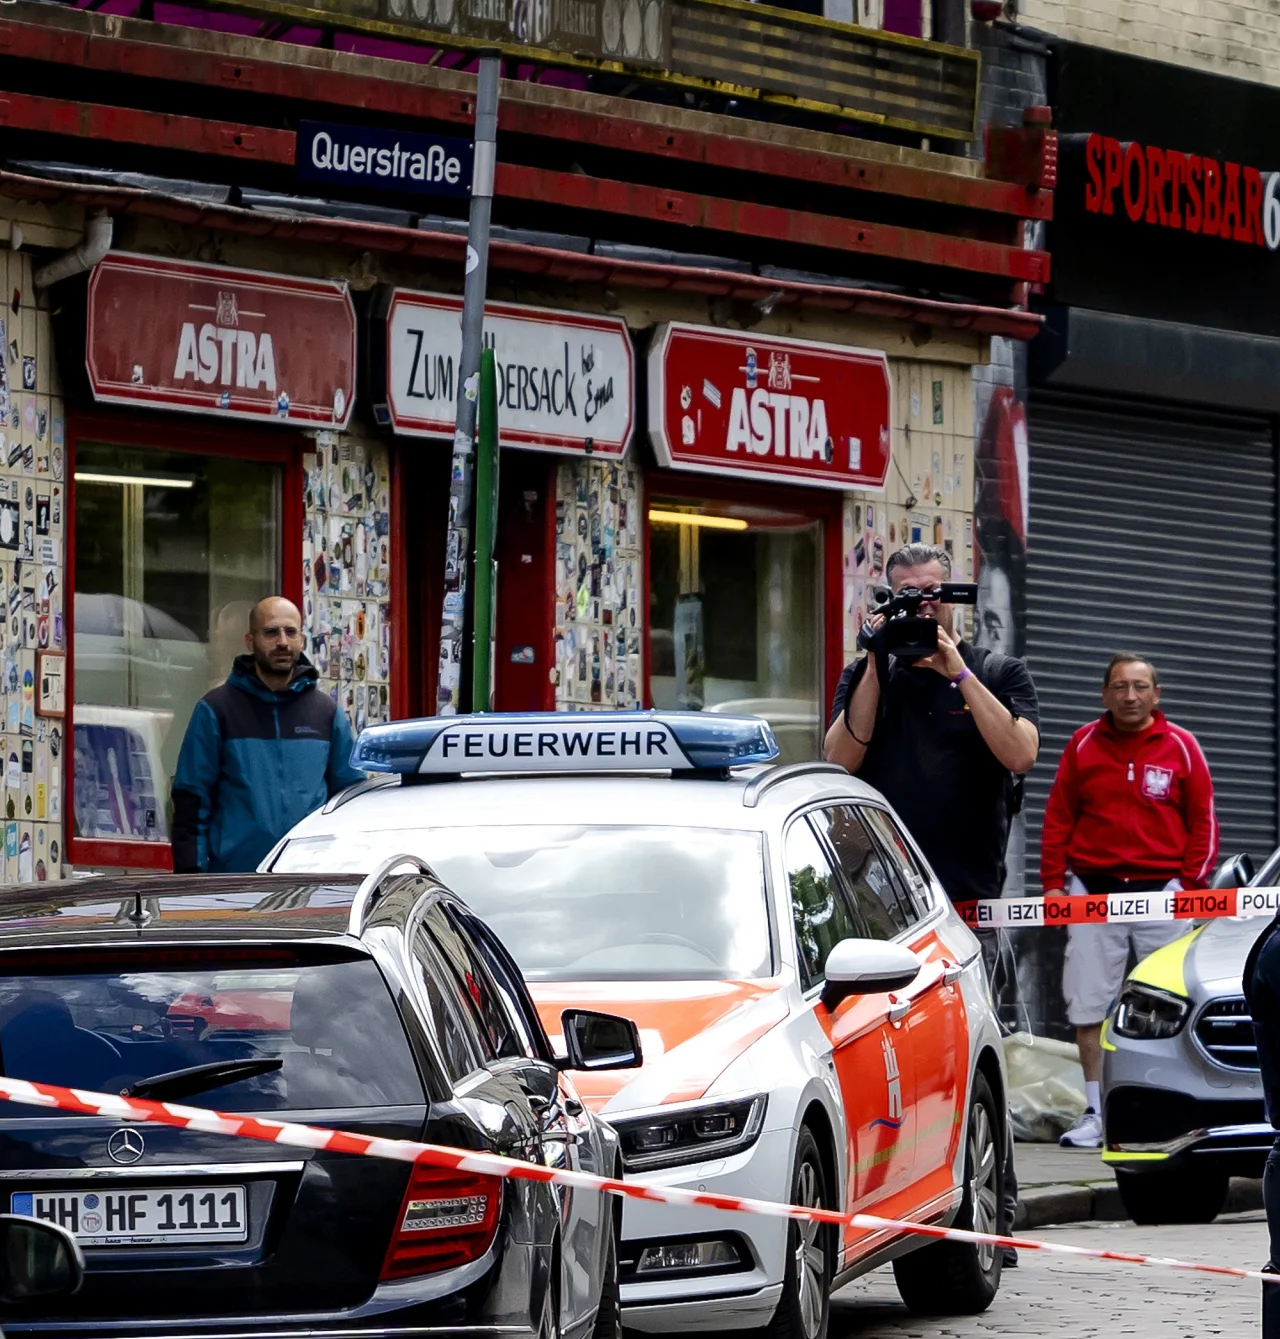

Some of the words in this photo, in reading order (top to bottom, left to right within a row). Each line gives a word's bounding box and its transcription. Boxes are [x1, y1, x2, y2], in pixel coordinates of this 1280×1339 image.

[311, 131, 462, 185] Querstraße
[1084, 131, 1266, 247] SPORTSBAR
[174, 321, 277, 393] ASTRA
[725, 386, 830, 461] ASTRA
[441, 731, 669, 759] FEUERWEHR
[961, 905, 993, 923] IZEI
[1007, 902, 1072, 921] POLIZEI
[1085, 900, 1150, 917] POLIZEI
[1164, 895, 1228, 914] POLIZEI
[36, 1196, 79, 1233] HH
[105, 1194, 149, 1232] HF
[156, 1191, 241, 1230] 1111
